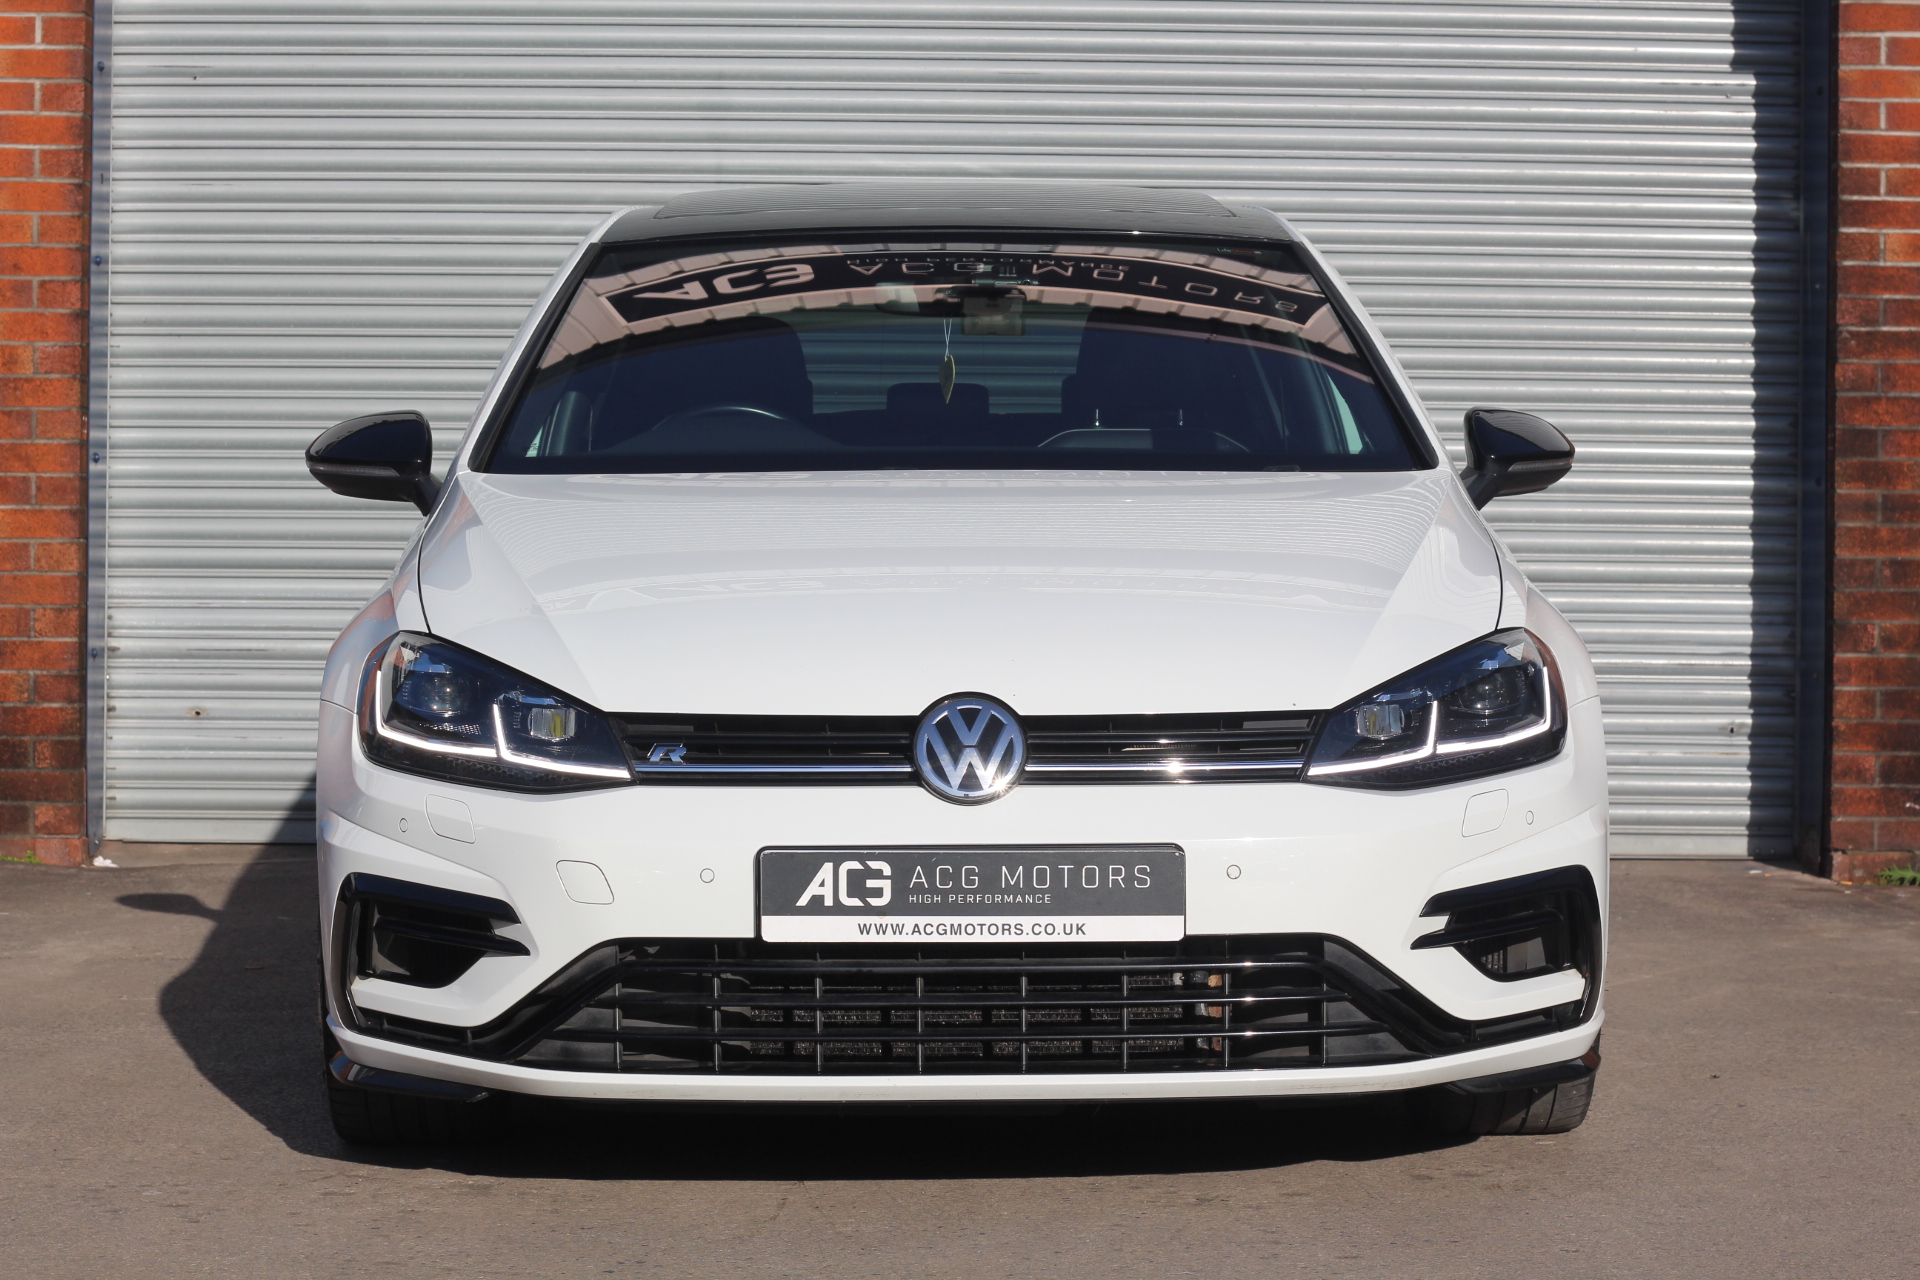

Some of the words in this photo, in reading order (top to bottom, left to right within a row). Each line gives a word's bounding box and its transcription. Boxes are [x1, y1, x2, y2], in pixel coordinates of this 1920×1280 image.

[648, 743, 687, 764] R
[796, 860, 892, 907] ACG
[909, 865, 979, 889] ACG
[1001, 864, 1151, 889] MOTORS
[909, 894, 941, 904] HIGH
[948, 893, 1052, 904] PERFORMANCE
[857, 923, 1087, 936] WWW.ACGMOTORS.CO.UK
